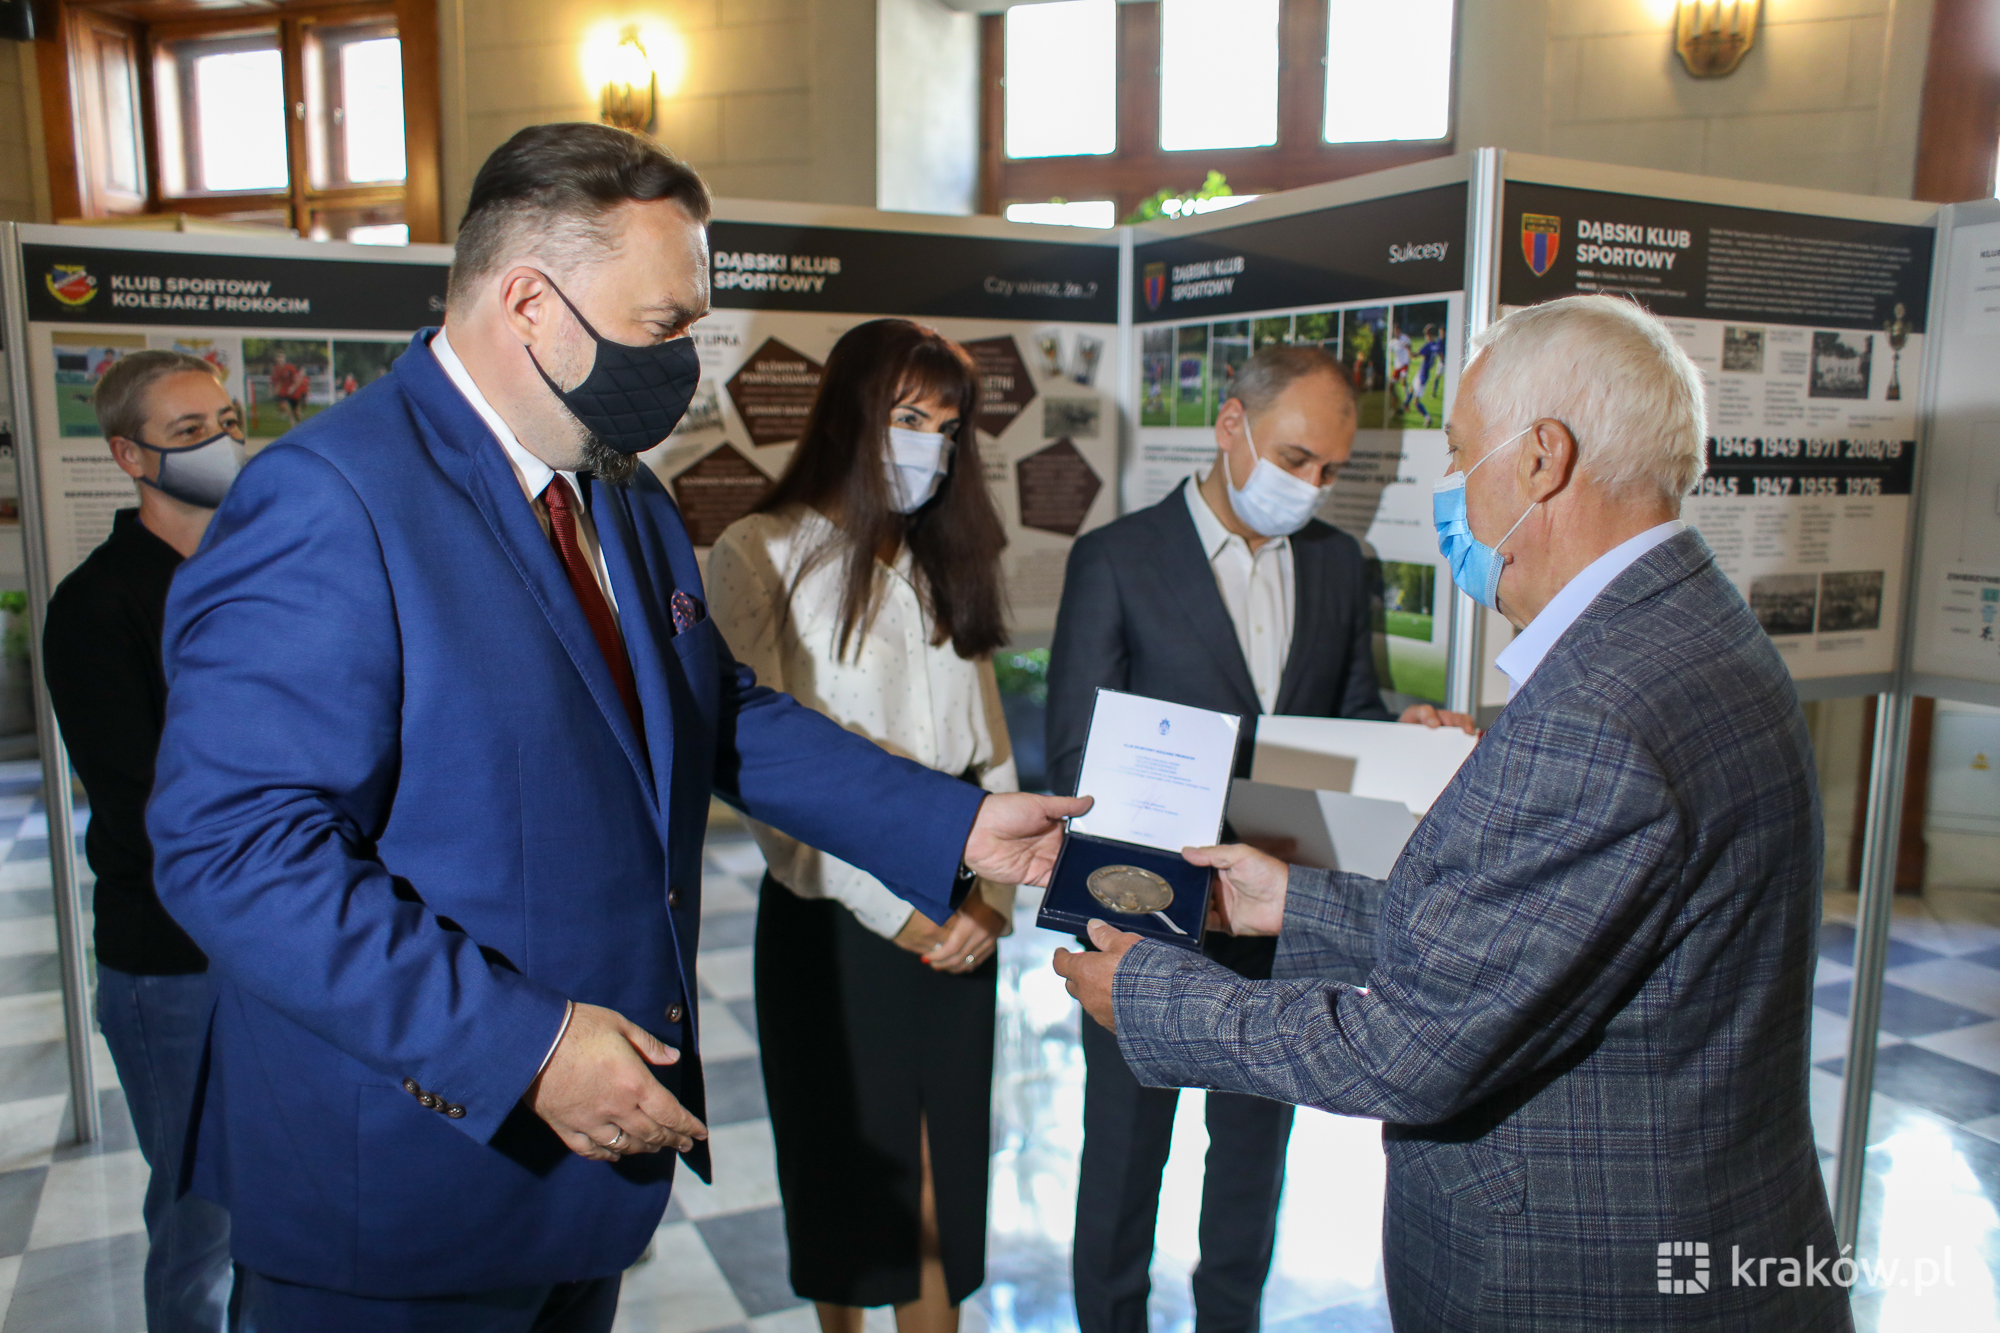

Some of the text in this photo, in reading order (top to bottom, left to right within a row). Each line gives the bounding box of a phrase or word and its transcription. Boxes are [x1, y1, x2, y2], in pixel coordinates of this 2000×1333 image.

[1577, 220, 1643, 245] DĄBSKI
[1646, 226, 1691, 249] KLUB
[714, 251, 841, 274] DĄBSKI KLUB
[1388, 241, 1449, 264] Sukcesy
[1576, 243, 1676, 270] SPORTOWY
[1214, 256, 1245, 276] KLUB
[110, 275, 272, 296] KLUB SPORTOWY
[714, 271, 825, 293] SPORTOWY
[984, 276, 1013, 297] Czy
[1171, 277, 1235, 302] SPORTOWY
[112, 292, 311, 314] KOLEJARZ PROKOCIM
[1714, 436, 1903, 461] 1946 1949 1971 2018/19
[1698, 476, 1882, 497] 1945 1947 1955 1976
